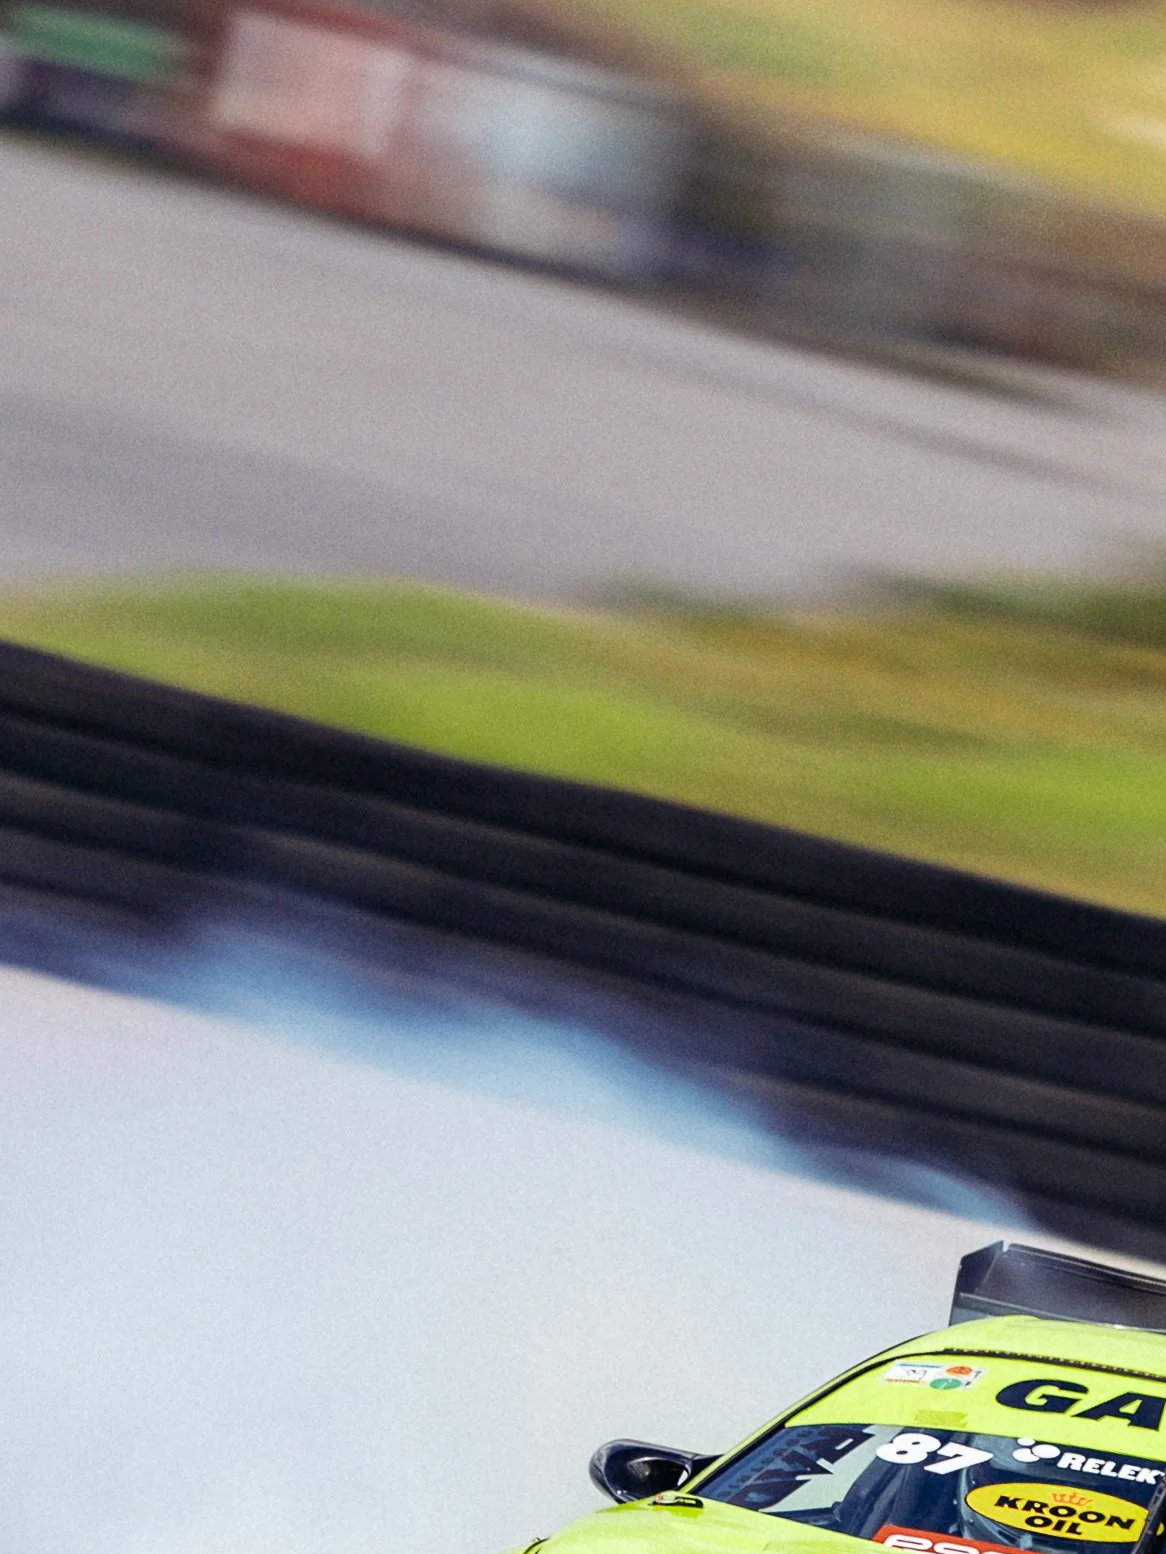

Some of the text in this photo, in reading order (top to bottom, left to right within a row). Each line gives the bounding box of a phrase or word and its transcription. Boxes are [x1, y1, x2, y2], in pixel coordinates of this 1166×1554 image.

[875, 1432, 994, 1475] 87
[994, 1495, 1136, 1530] KROON
[1025, 1515, 1083, 1536] OIL
